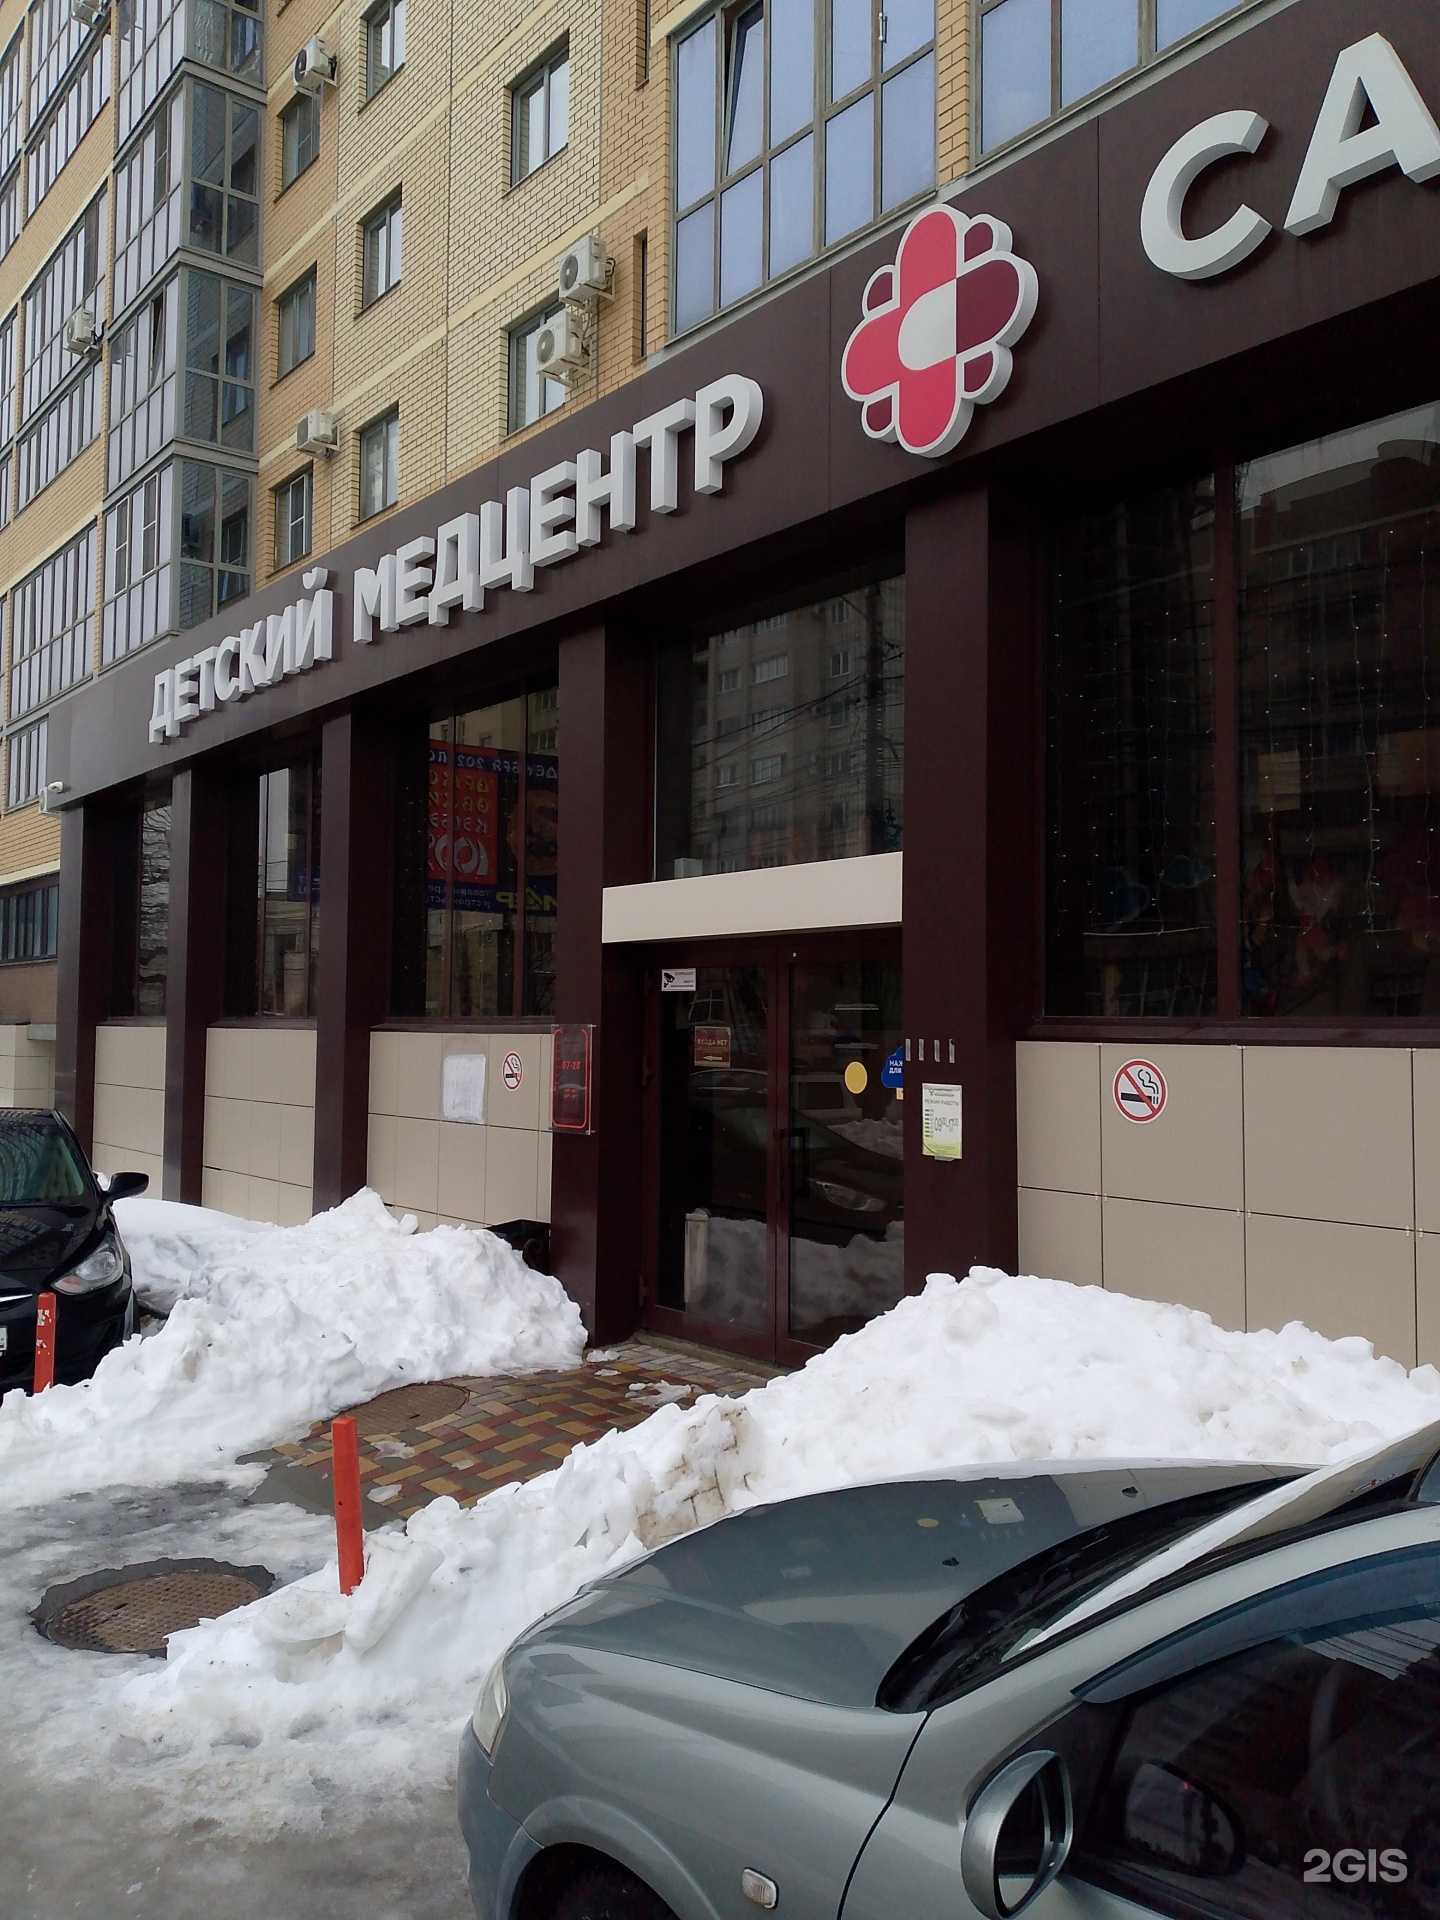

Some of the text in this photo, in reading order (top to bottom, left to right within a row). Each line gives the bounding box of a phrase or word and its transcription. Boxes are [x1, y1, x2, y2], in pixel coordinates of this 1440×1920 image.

[148, 32, 1440, 744] ДЕТСКИЙ МЕДЦЕНТР СА
